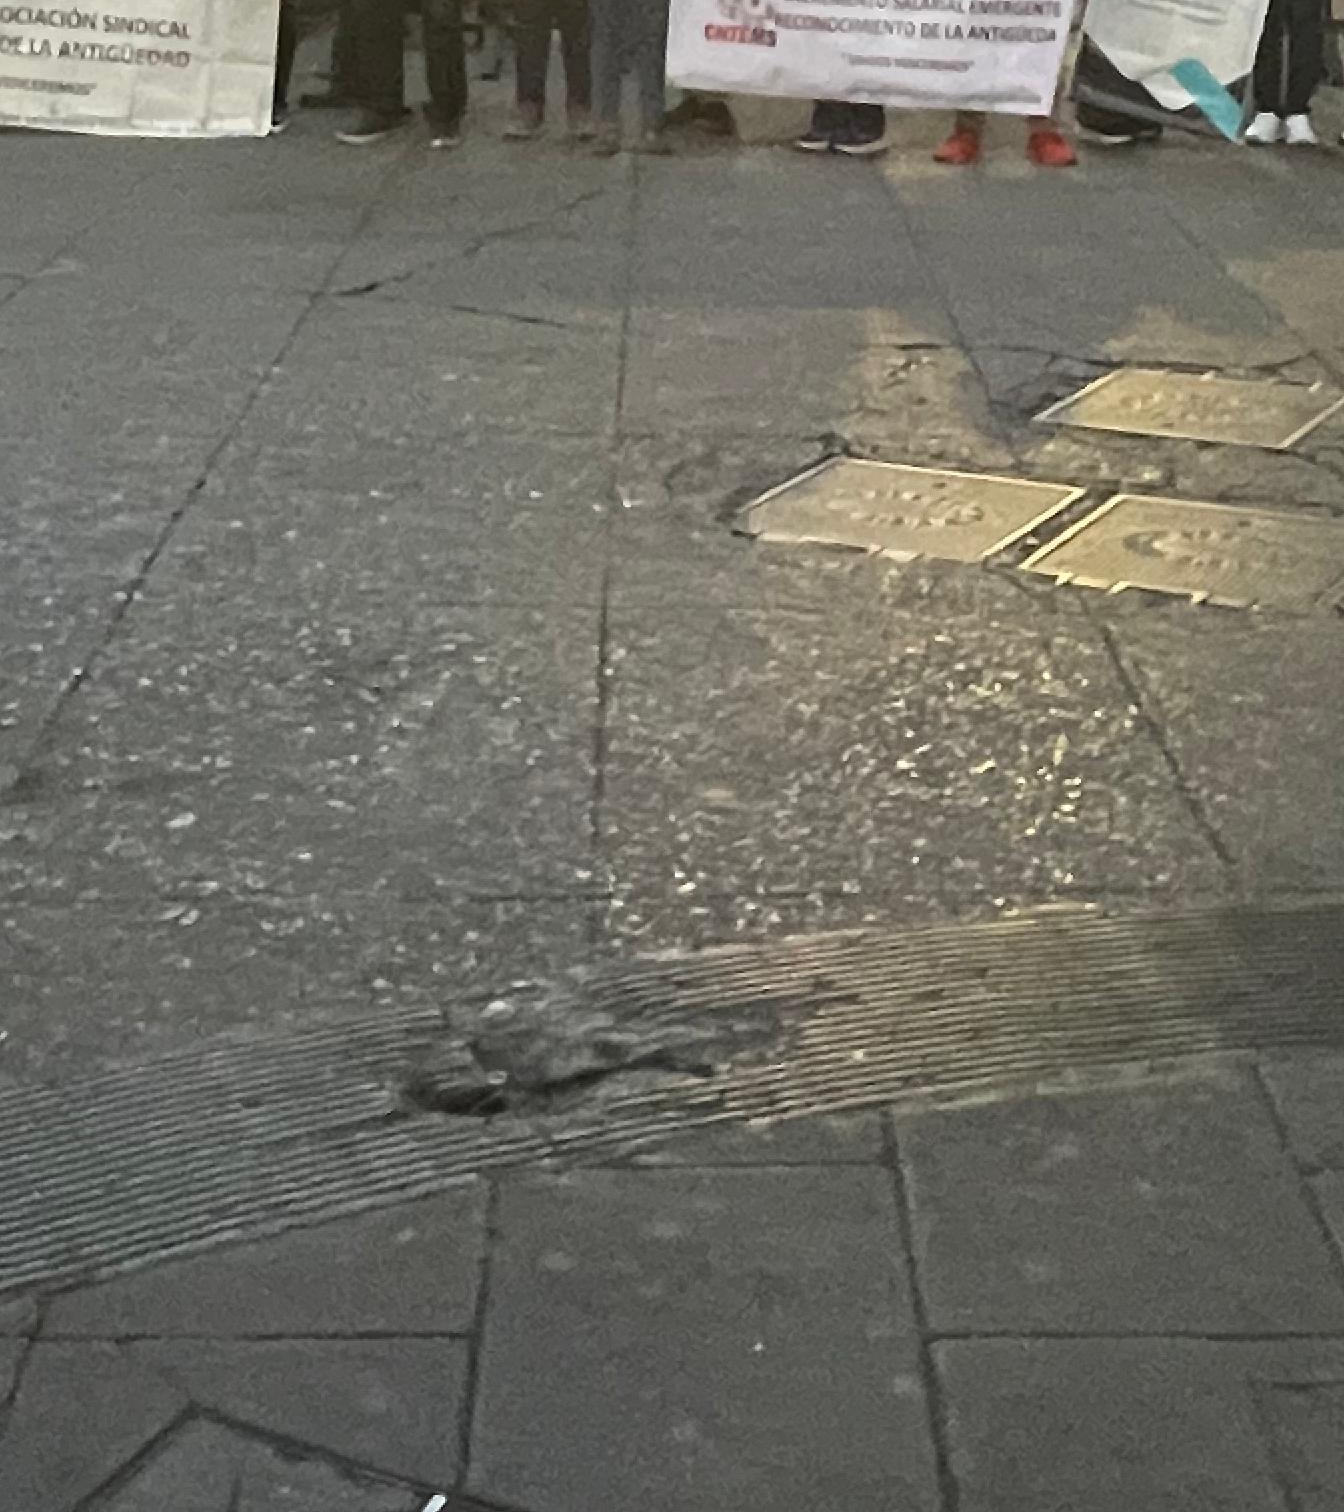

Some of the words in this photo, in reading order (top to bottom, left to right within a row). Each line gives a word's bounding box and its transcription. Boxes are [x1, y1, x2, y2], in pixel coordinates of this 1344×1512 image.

[969, 0, 1061, 18] EMERGENTE
[102, 14, 190, 40] SINDICAL
[775, 13, 915, 37] RECONOCIMIENTO
[921, 22, 939, 40] DE
[945, 23, 963, 40] LA
[28, 38, 51, 58] LA
[57, 40, 190, 68] ANTIGÜEDAD
